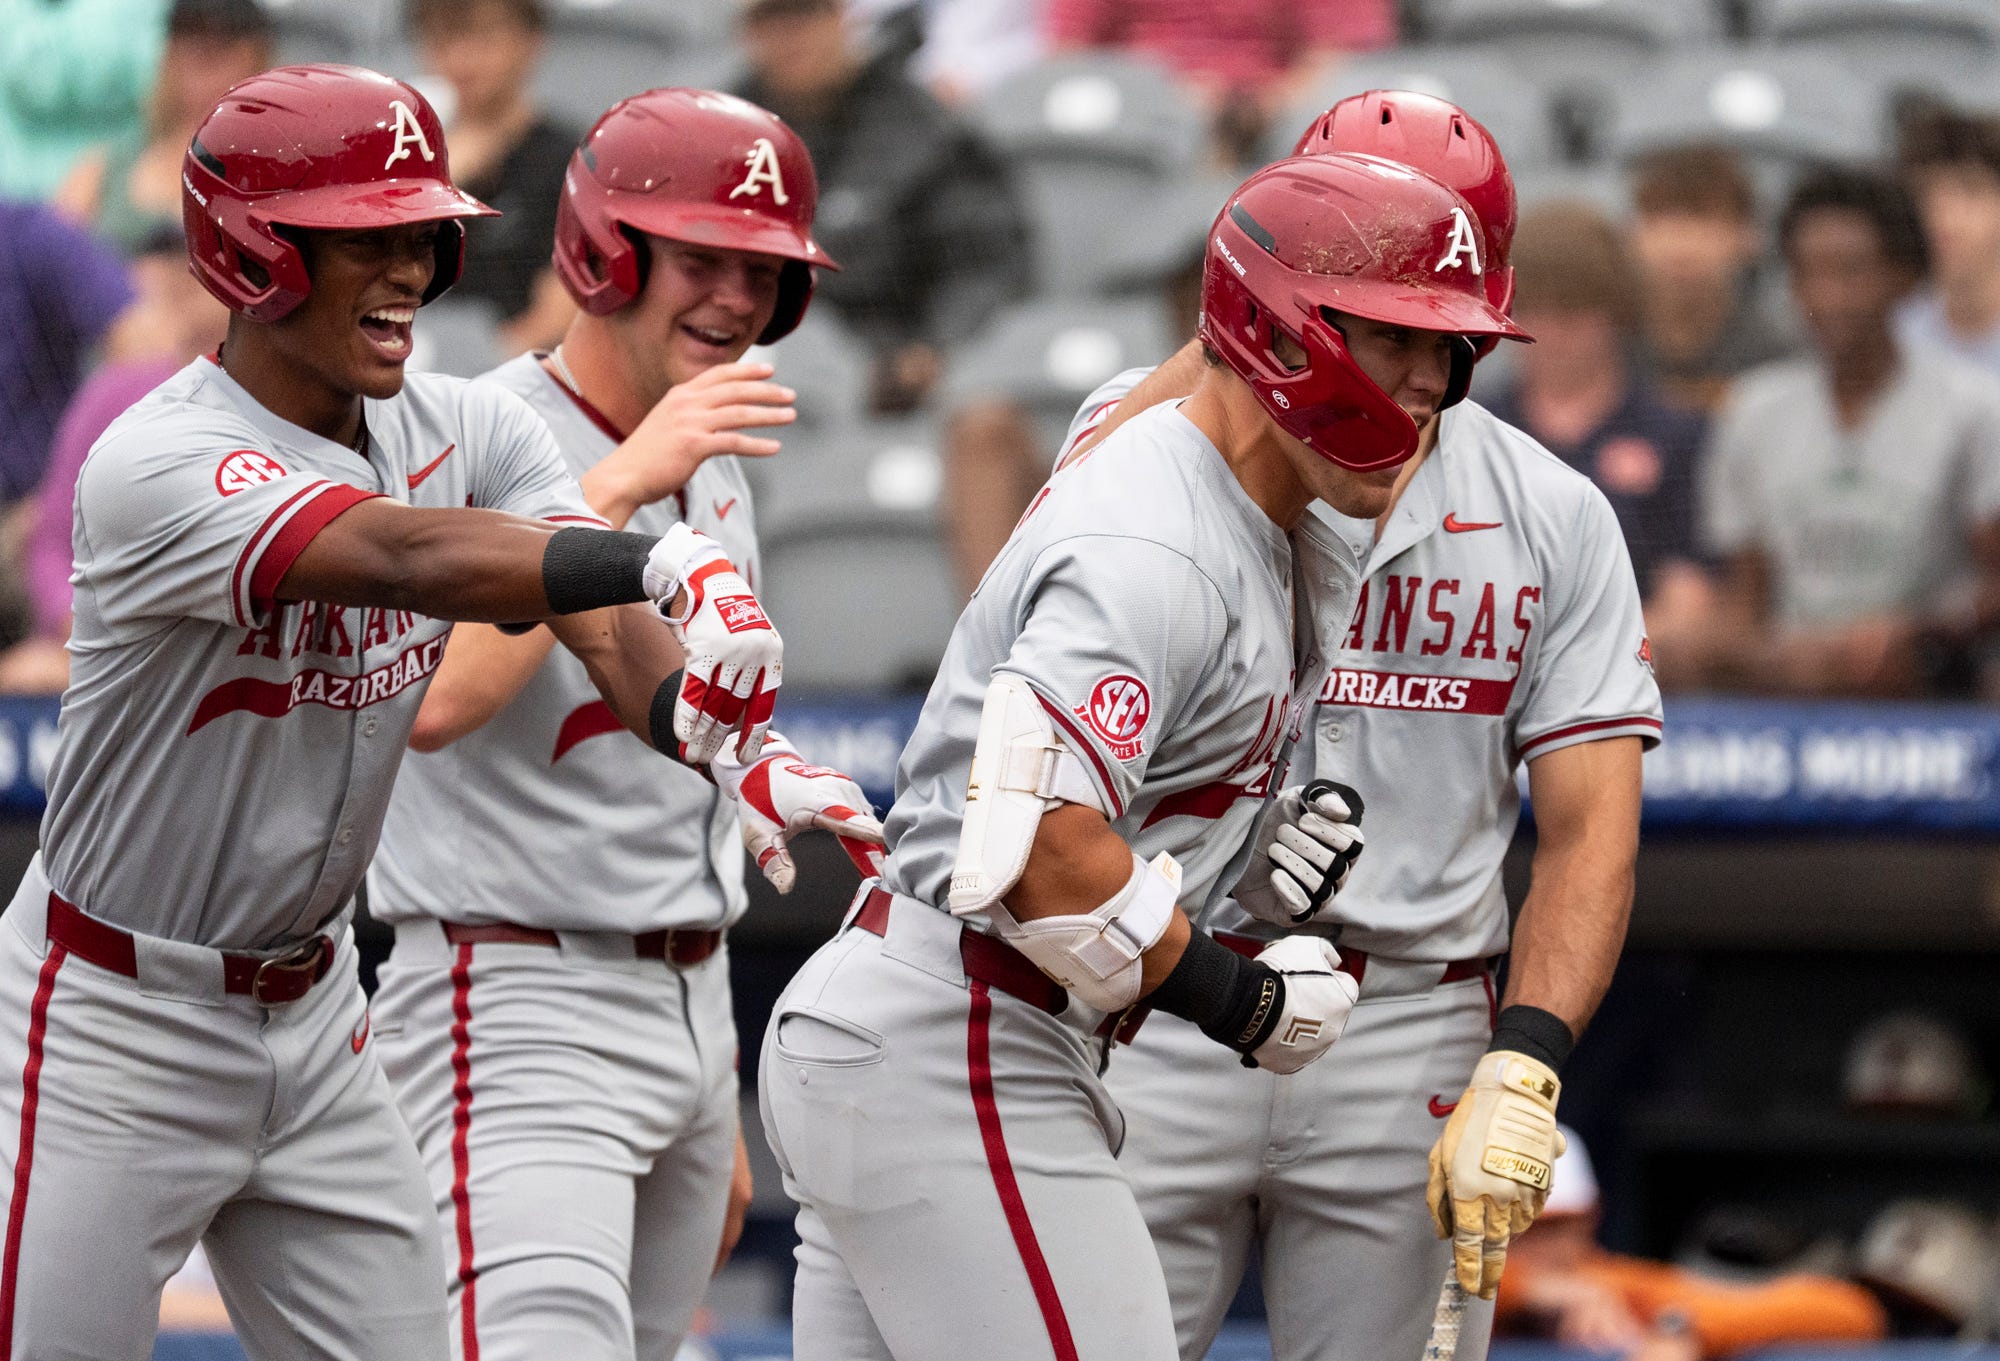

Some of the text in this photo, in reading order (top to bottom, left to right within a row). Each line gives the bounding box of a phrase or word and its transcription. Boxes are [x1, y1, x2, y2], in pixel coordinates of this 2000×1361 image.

[384, 100, 435, 171] A
[728, 137, 790, 206] A
[1215, 235, 1247, 278] RAWLINGS
[1434, 207, 1482, 276] A
[220, 453, 283, 493] SEC
[1094, 680, 1146, 738] SEC
[1486, 1154, 1548, 1185] Franklin
